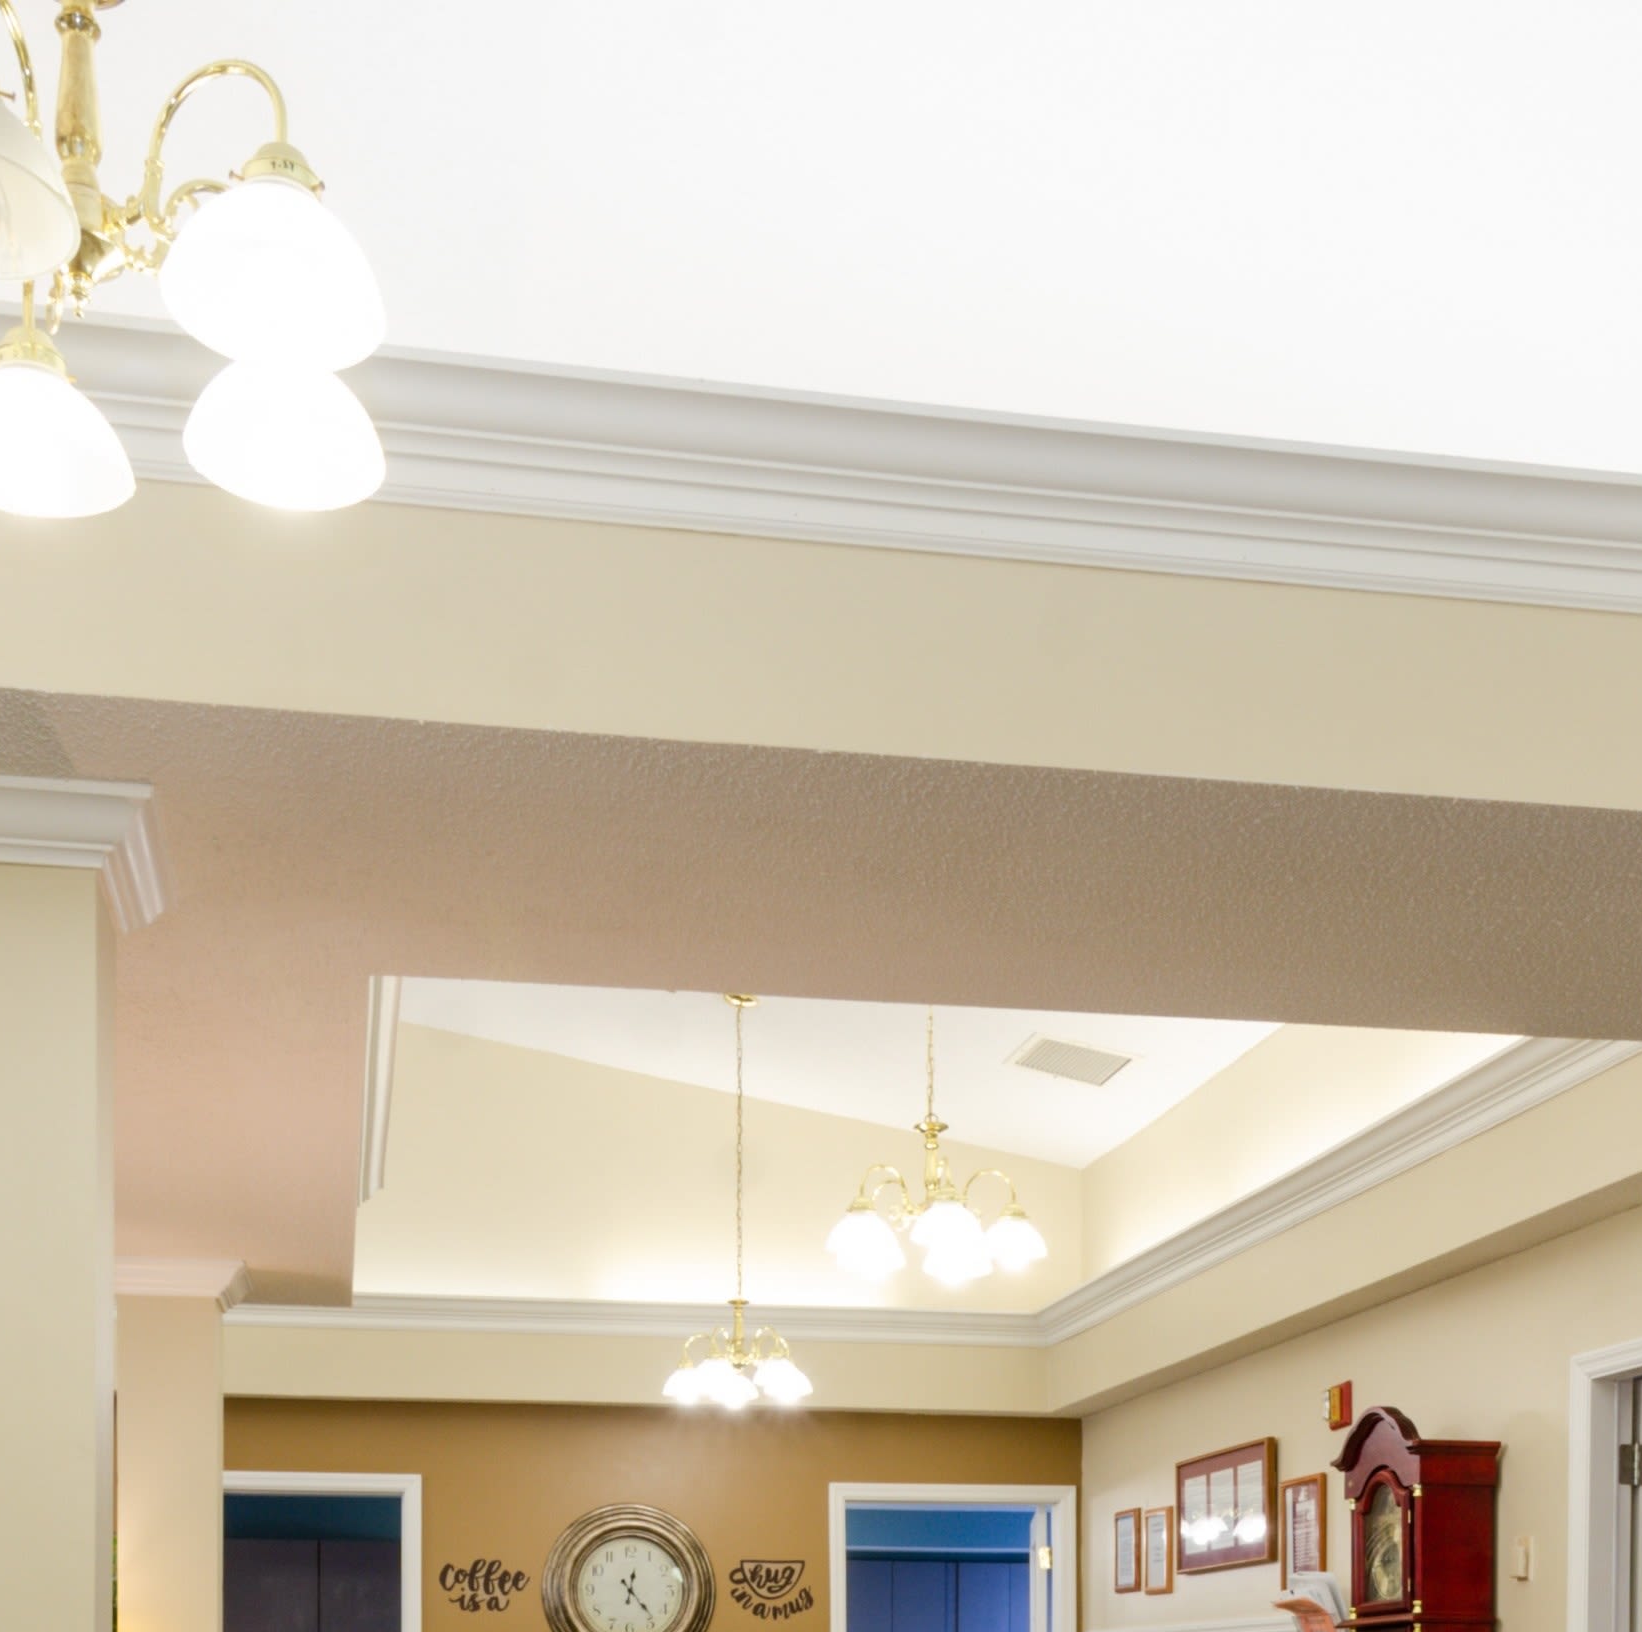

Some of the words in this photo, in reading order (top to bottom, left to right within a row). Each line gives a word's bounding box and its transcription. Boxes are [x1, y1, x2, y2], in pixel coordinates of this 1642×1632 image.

[749, 1564, 795, 1594] hug
[448, 1587, 485, 1612] is
[486, 1596, 510, 1612] a
[730, 1586, 753, 1610] in
[752, 1602, 770, 1620] a
[772, 1585, 814, 1620] mug
